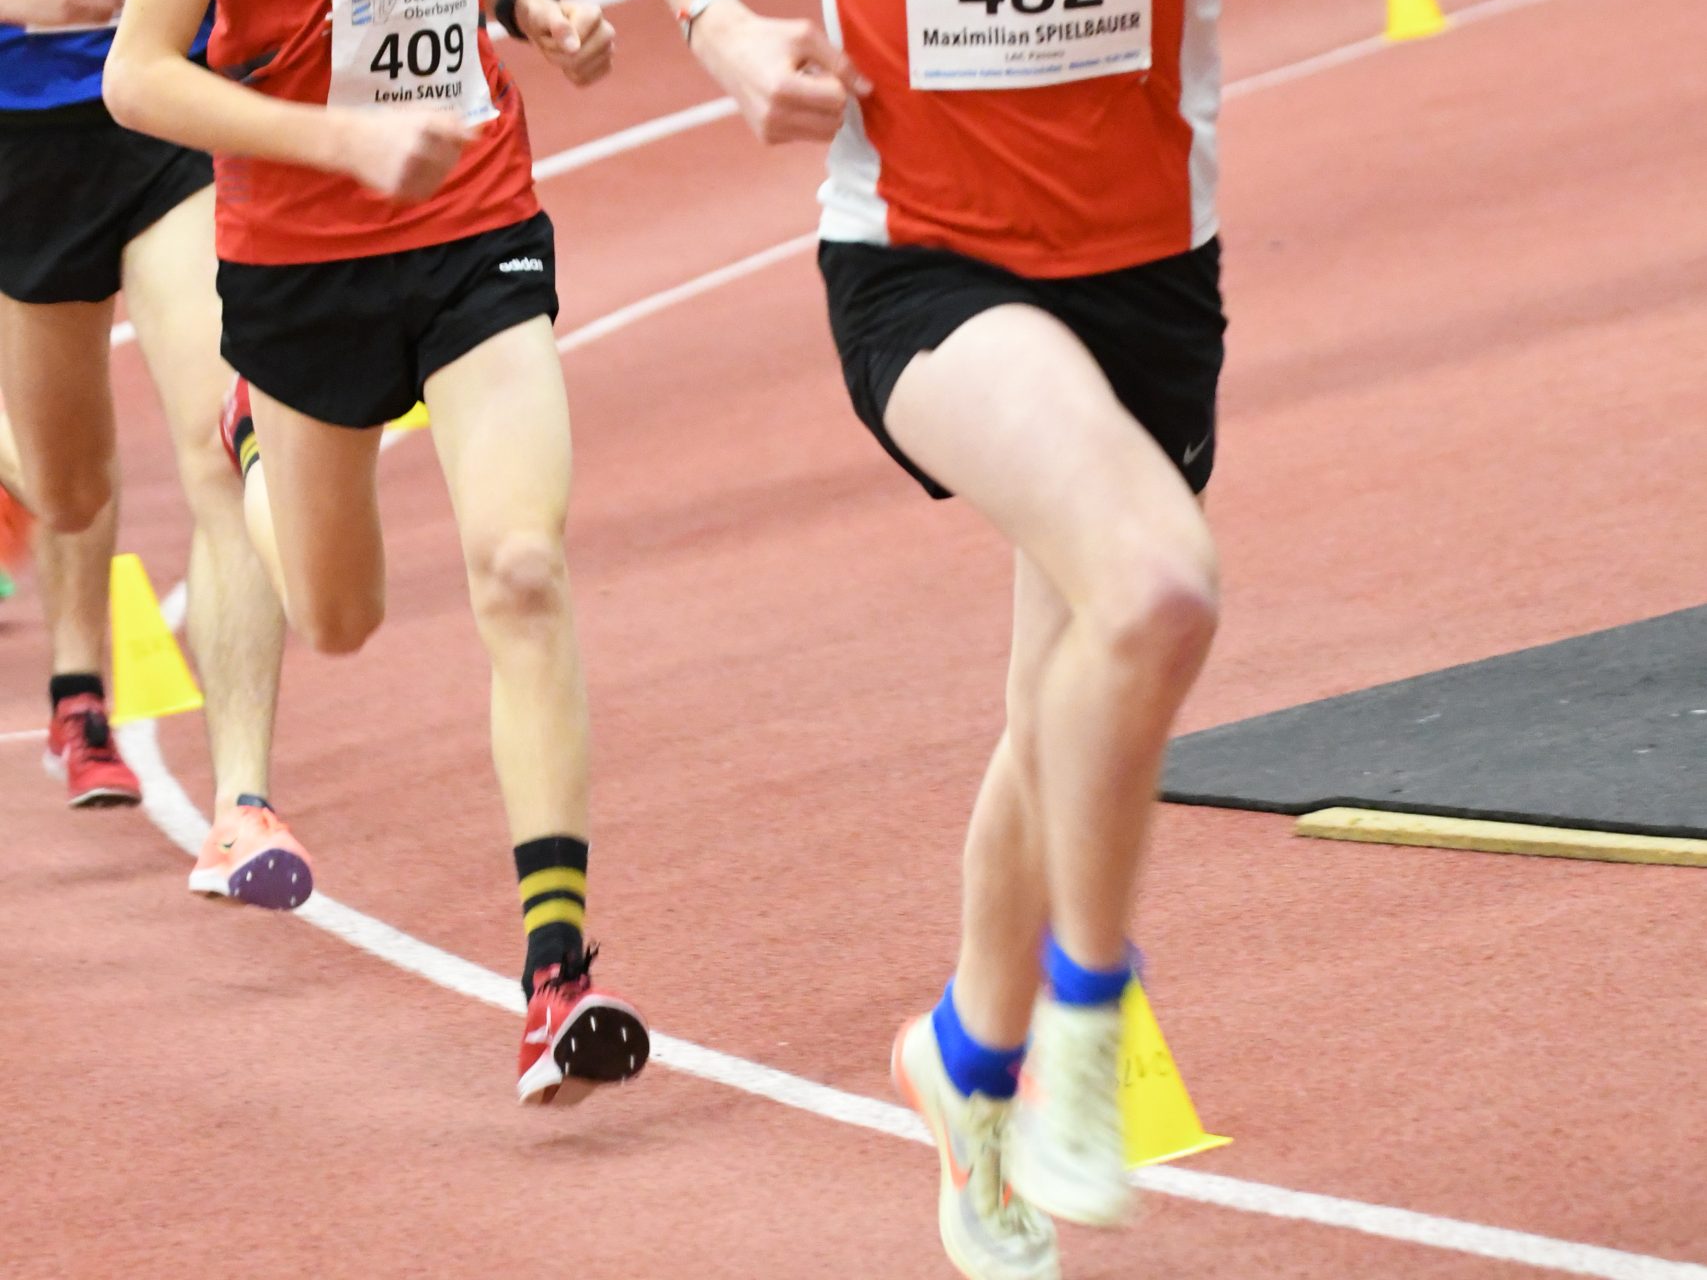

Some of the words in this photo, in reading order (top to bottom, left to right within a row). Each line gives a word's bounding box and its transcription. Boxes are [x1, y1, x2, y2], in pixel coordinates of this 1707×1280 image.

[922, 26, 1030, 47] Maximilian
[1035, 12, 1141, 45] SPIELBAUER
[370, 23, 464, 80] 409
[374, 86, 413, 103] Levin
